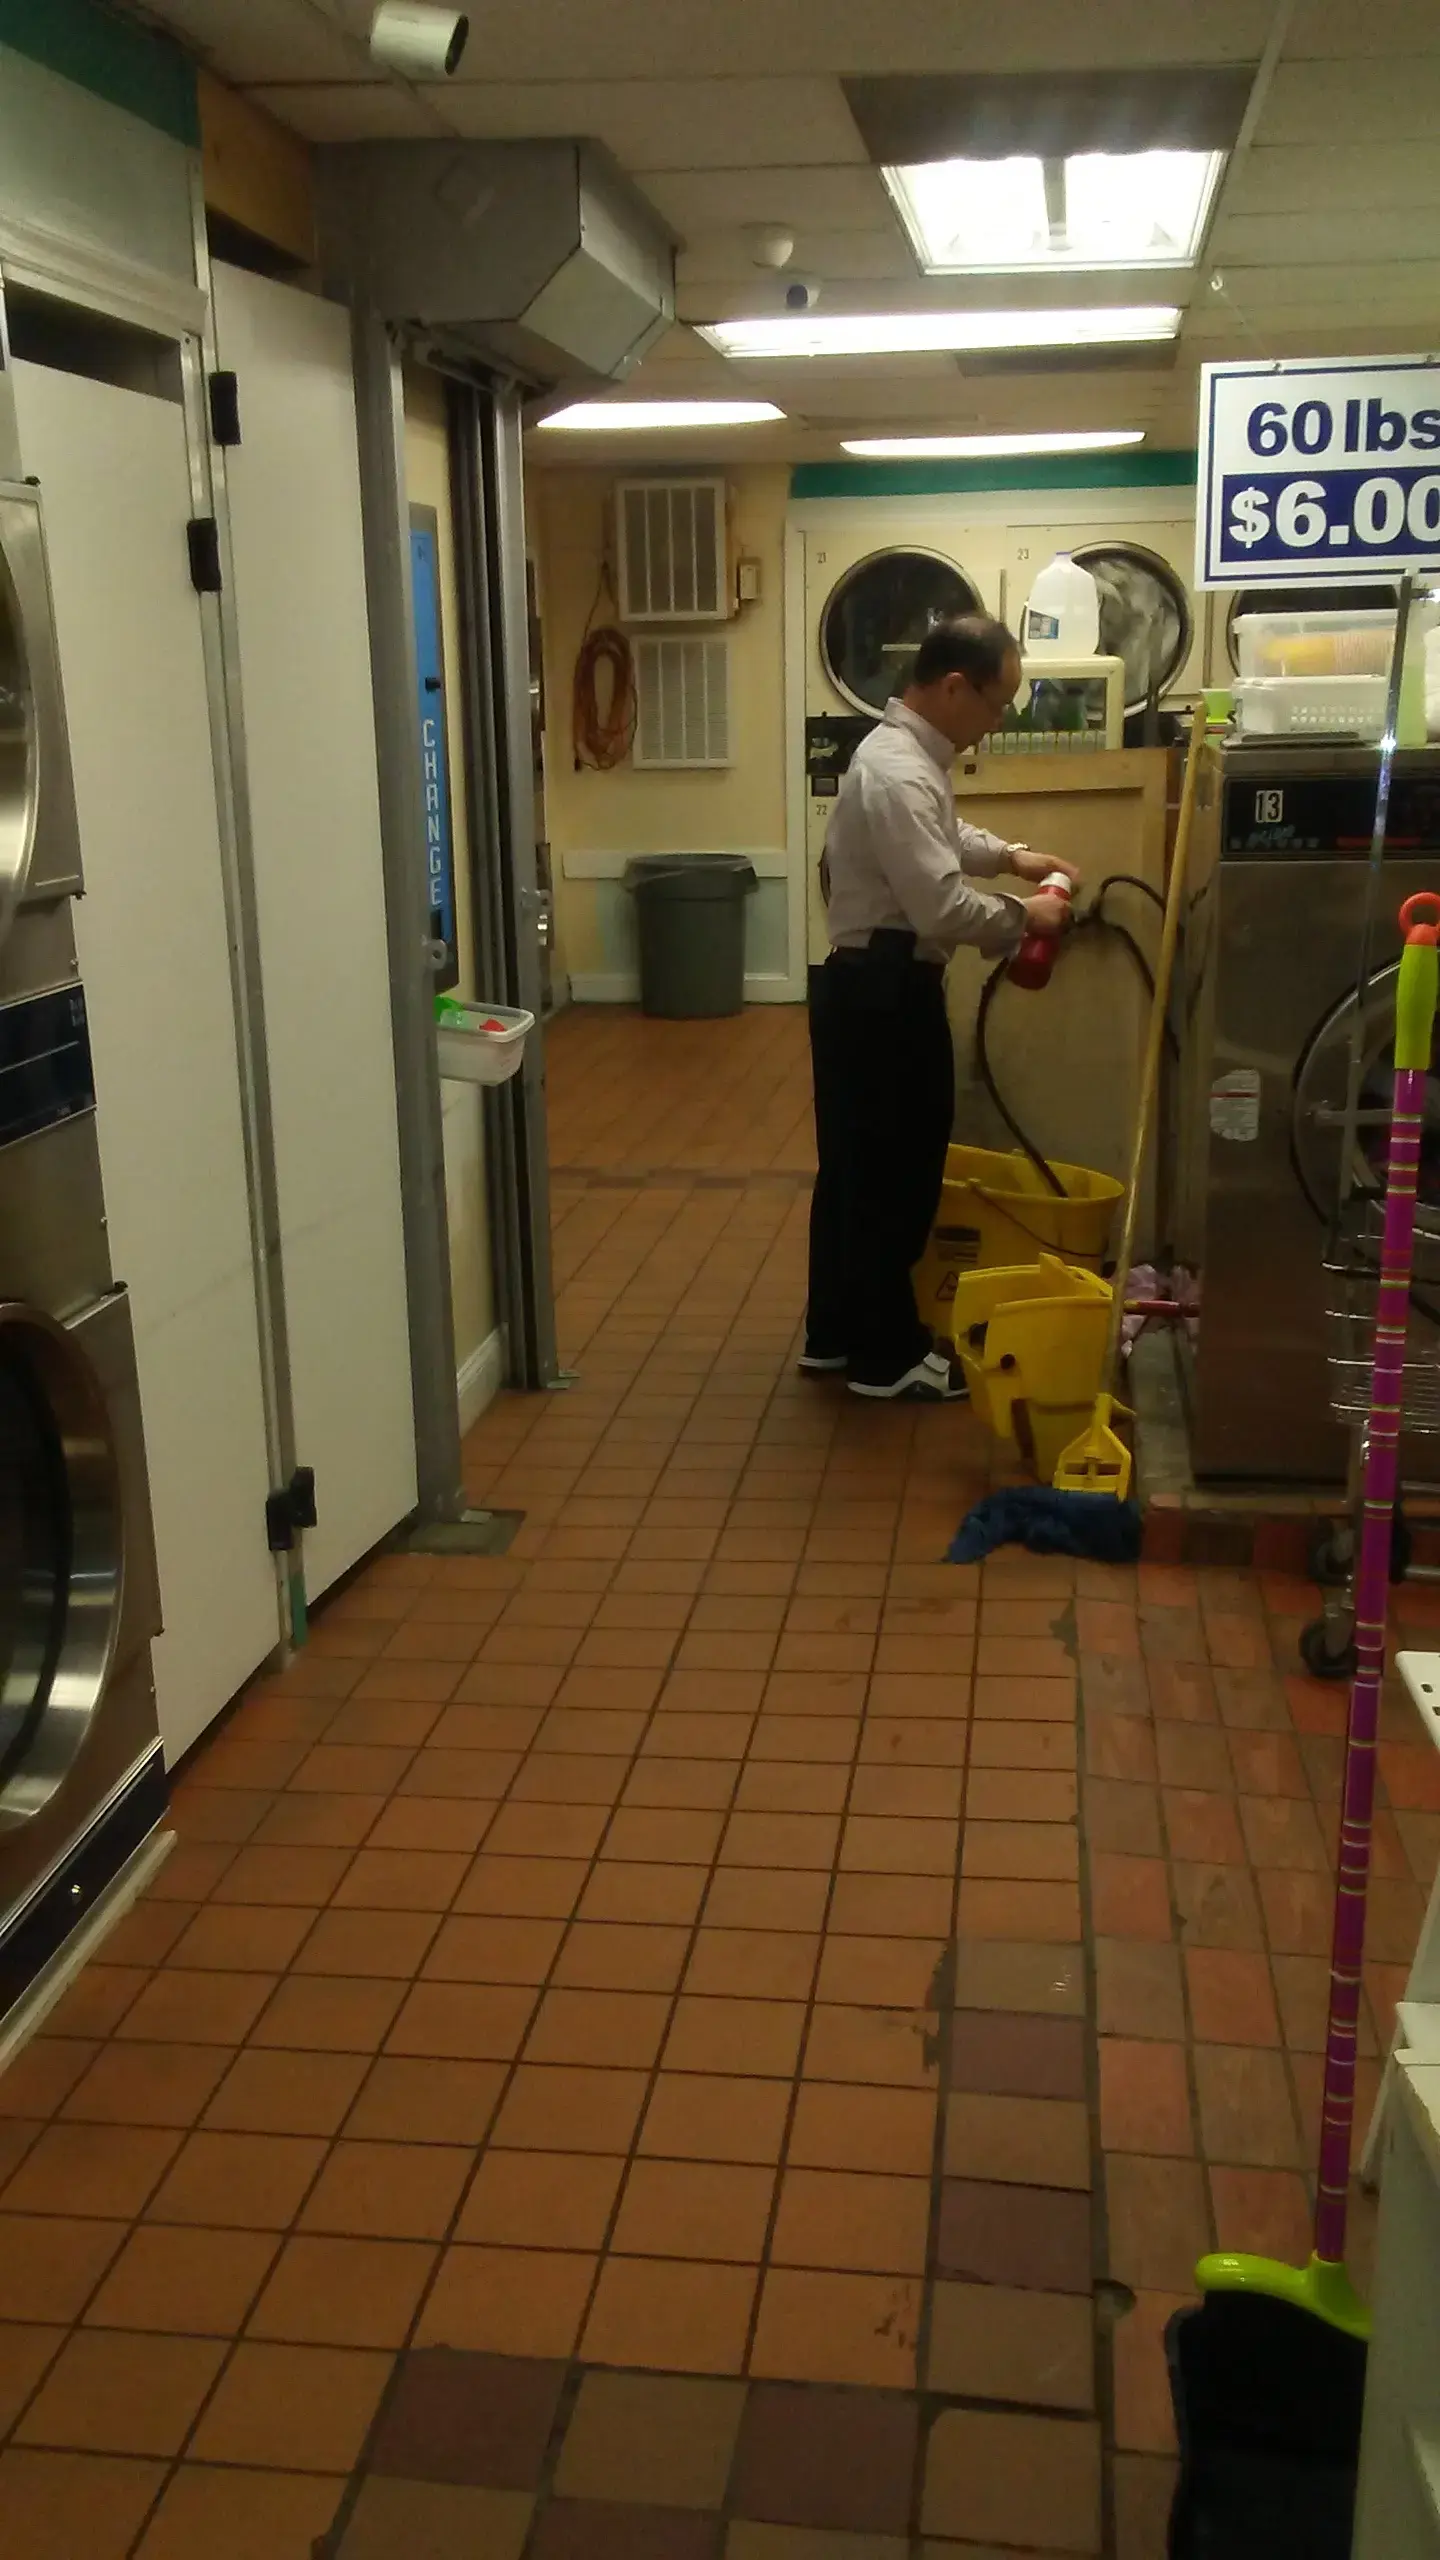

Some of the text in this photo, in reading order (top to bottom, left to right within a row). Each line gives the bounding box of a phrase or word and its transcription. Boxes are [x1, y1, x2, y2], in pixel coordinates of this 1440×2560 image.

[1247, 398, 1440, 457] 60 lbs
[1228, 474, 1440, 549] $6.00
[422, 718, 443, 906] CHANGE
[1258, 792, 1280, 821] 13
